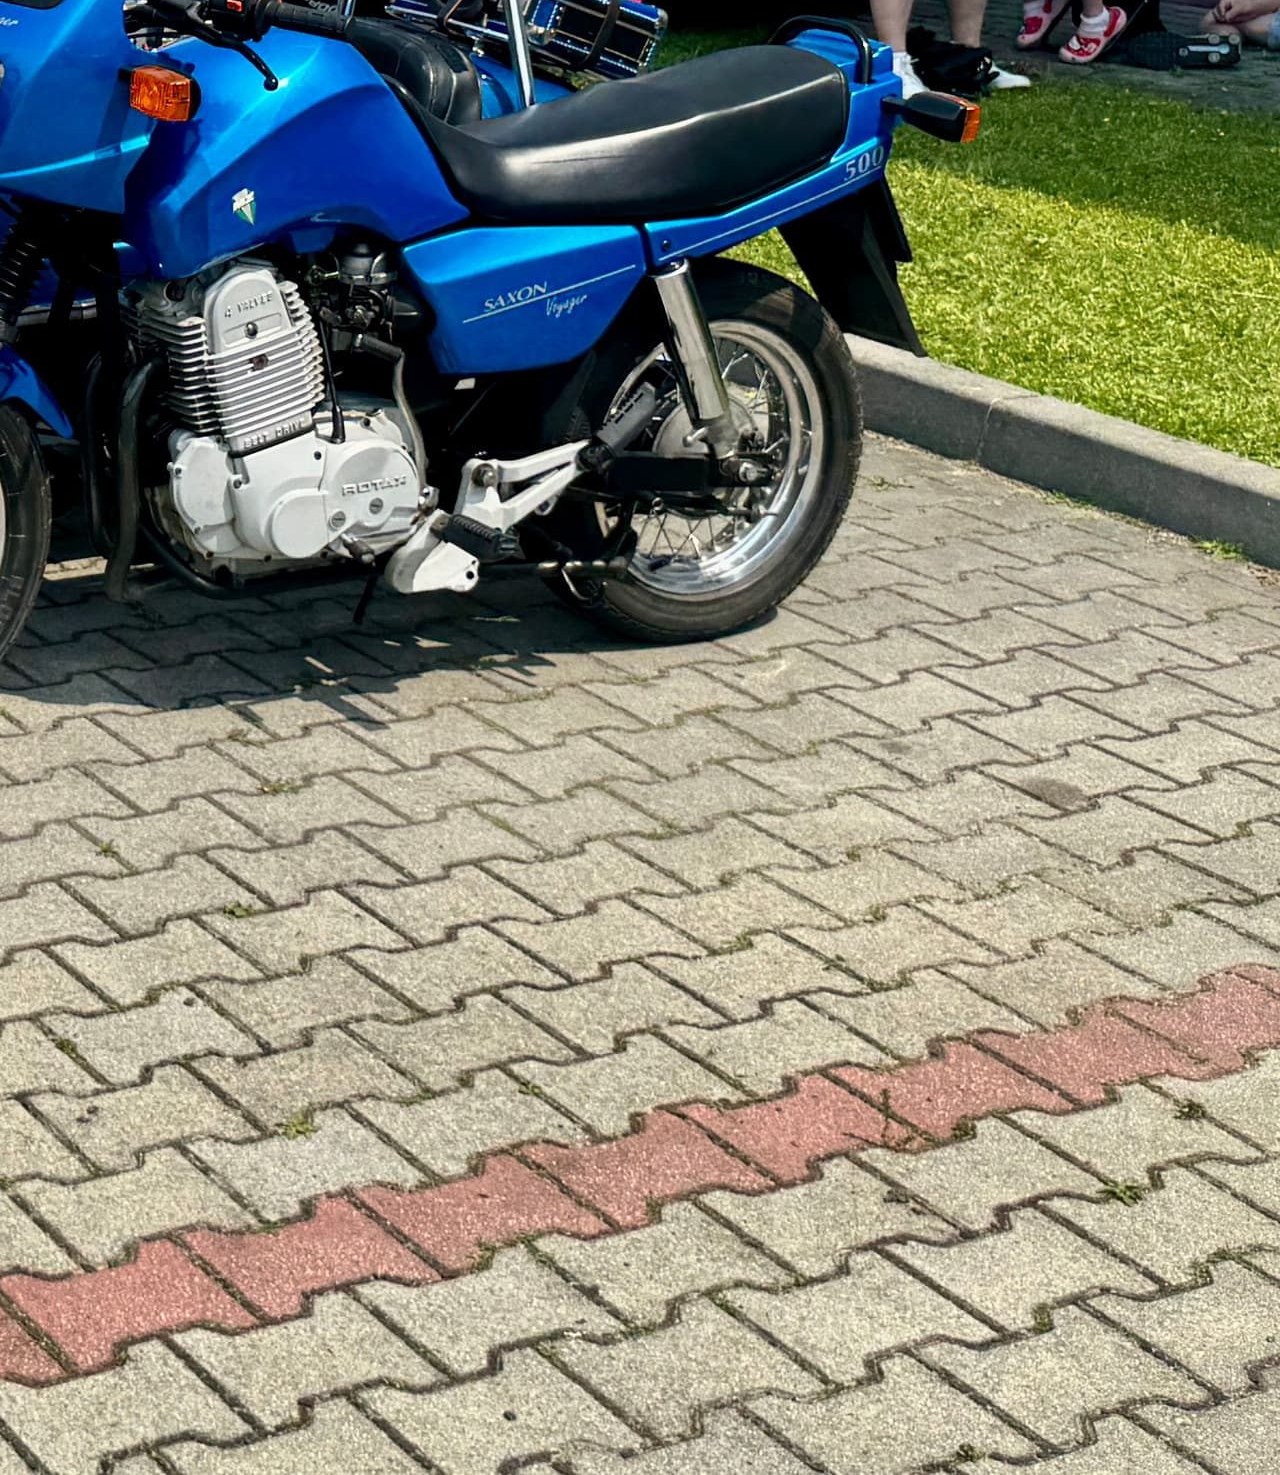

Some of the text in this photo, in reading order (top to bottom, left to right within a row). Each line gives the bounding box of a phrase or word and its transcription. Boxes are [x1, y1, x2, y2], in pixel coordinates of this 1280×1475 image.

[843, 145, 885, 182] 500
[483, 280, 549, 313] SAXON
[546, 293, 588, 319] Voyager
[341, 474, 408, 497] ROTAX
